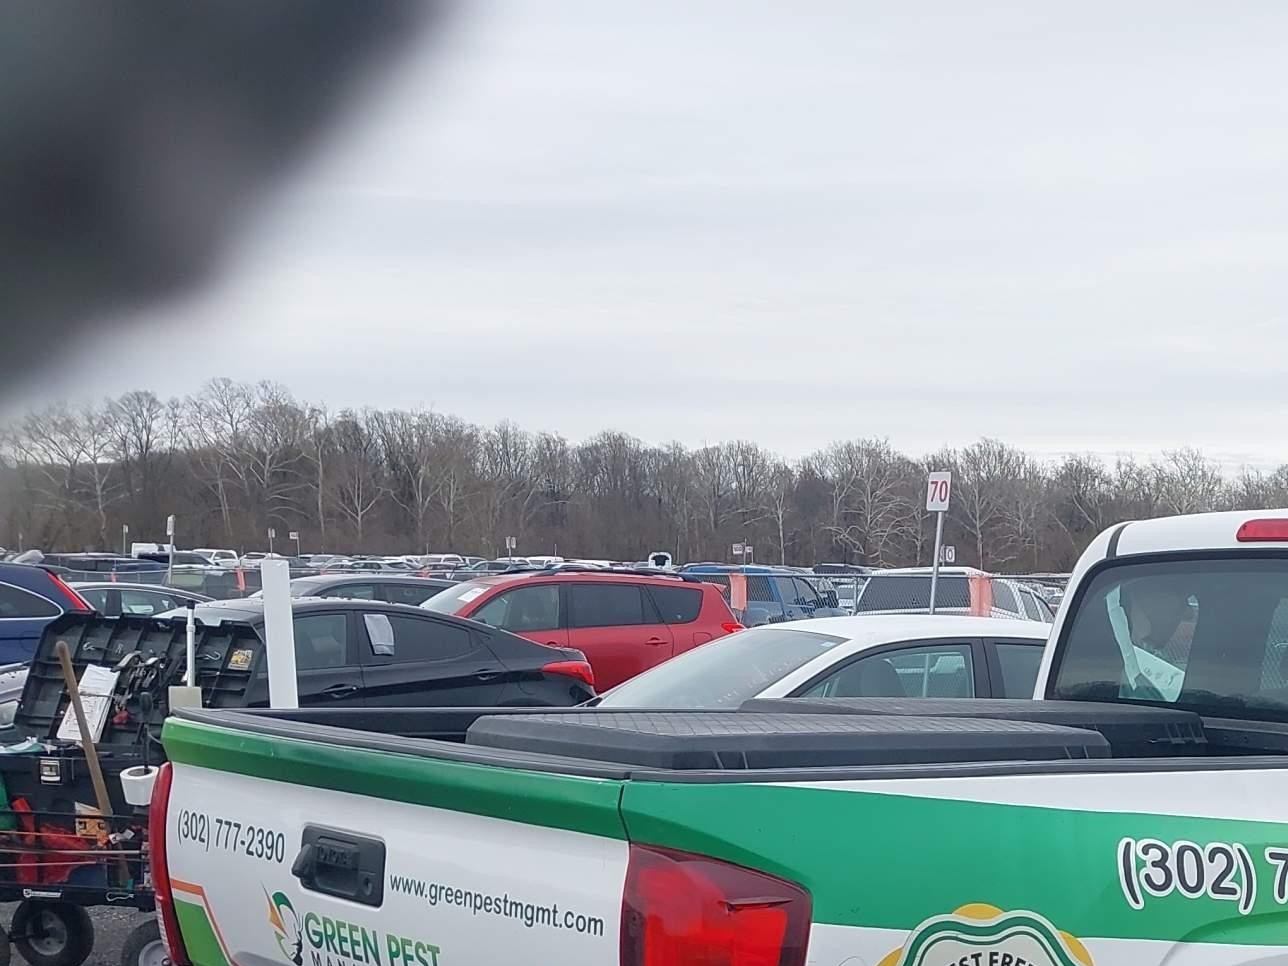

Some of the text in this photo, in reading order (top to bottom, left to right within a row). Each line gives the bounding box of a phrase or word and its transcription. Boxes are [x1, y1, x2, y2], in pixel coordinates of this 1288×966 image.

[928, 480, 949, 502] 70
[178, 808, 210, 853] (302)
[215, 817, 285, 864] 777-2390
[389, 873, 605, 937] www.greenpestmgmt.com
[1120, 839, 1255, 913] (302)
